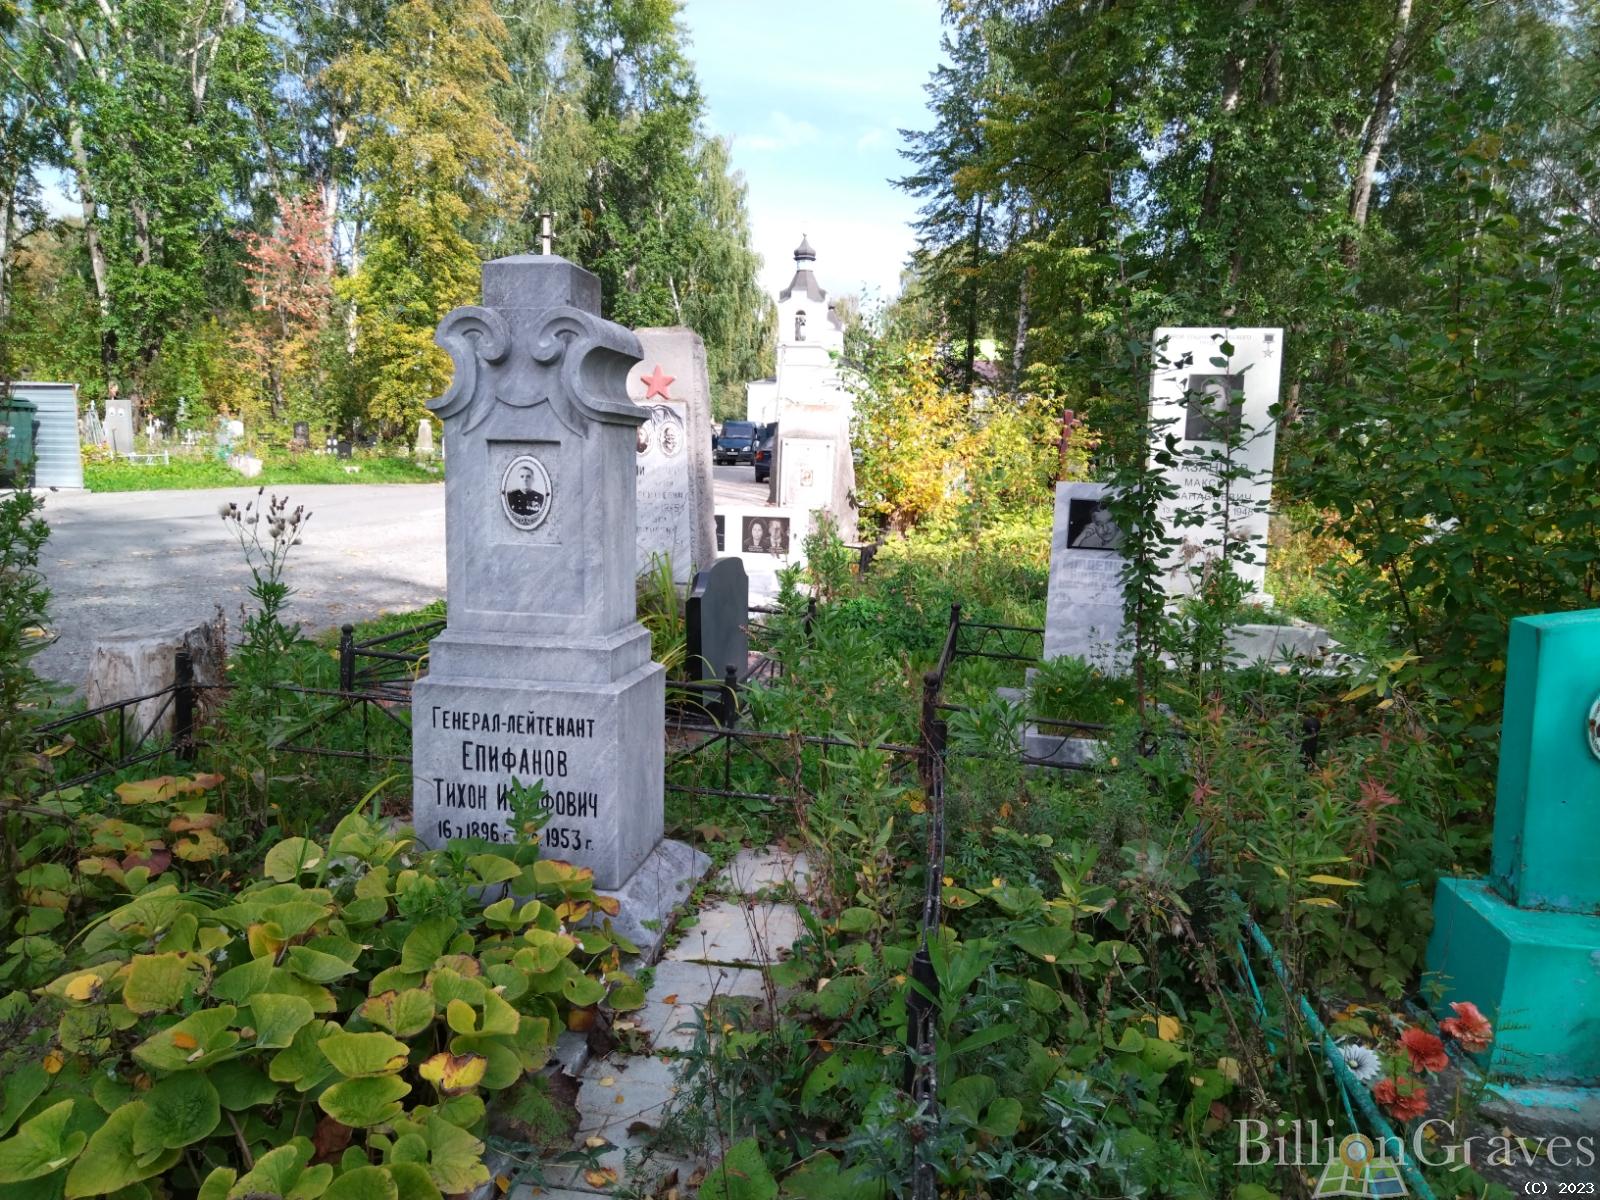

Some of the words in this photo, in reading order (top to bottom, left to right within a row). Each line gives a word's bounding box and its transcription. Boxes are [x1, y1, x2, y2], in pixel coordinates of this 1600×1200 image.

[462, 741, 568, 777] ЕПИФАНОВ
[434, 778, 487, 810] ТИХОН
[497, 783, 598, 818] ИОФОВИЧ
